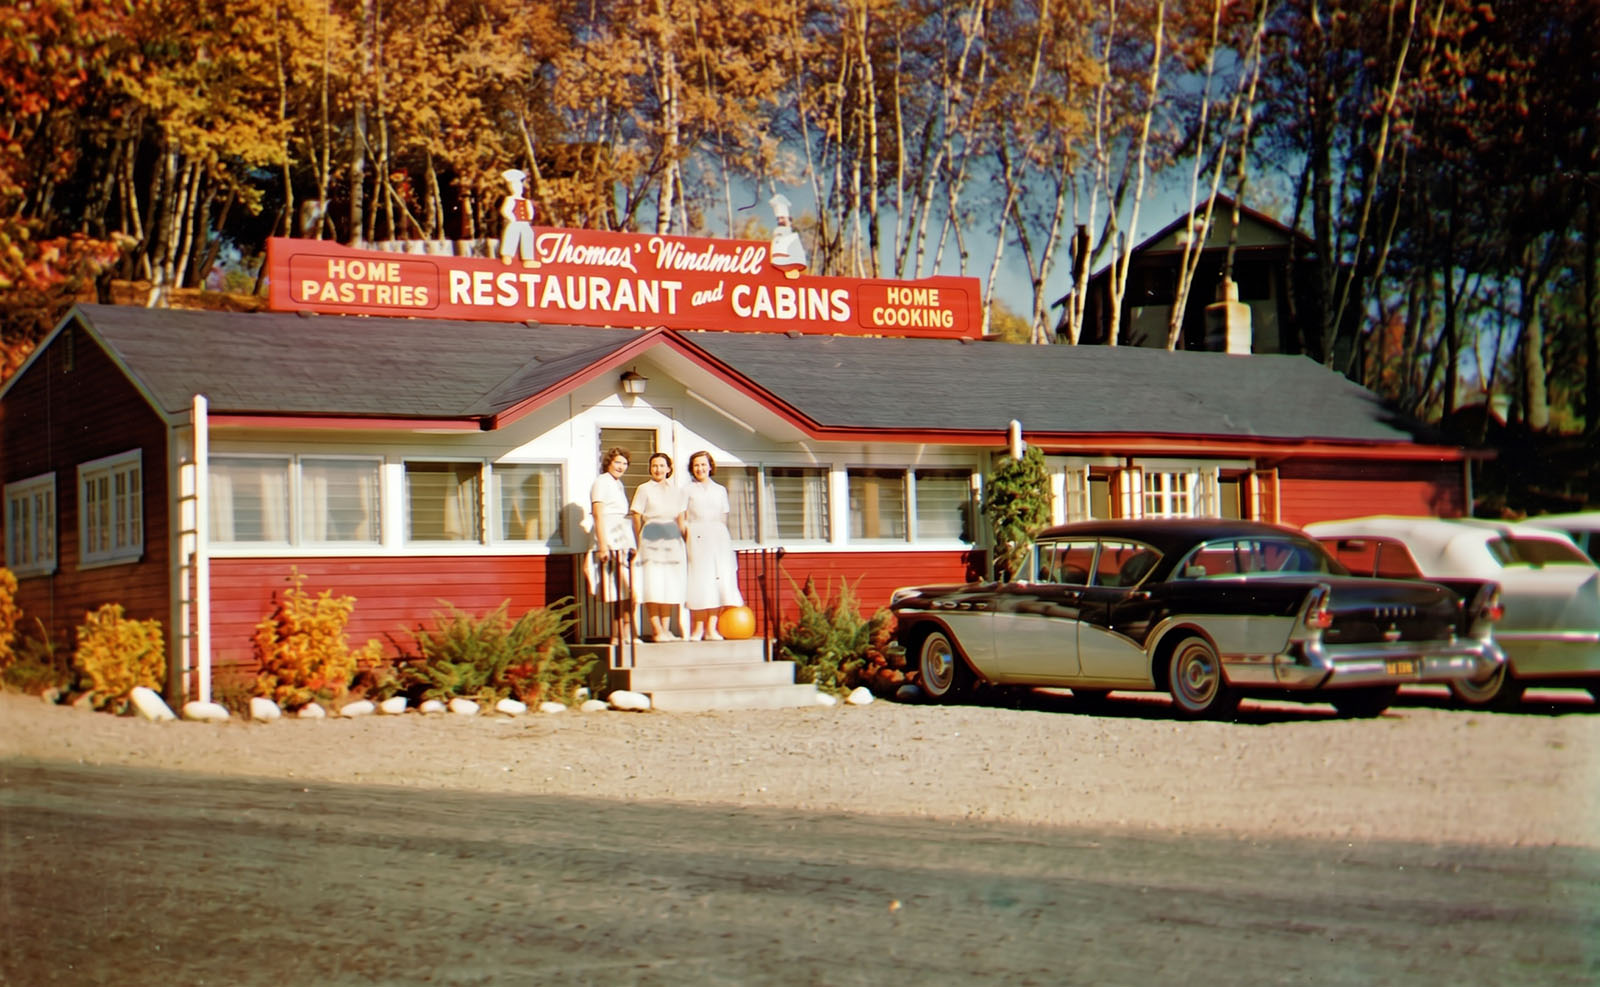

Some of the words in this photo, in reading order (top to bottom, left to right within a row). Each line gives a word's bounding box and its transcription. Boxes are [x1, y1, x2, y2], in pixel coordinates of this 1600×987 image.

[536, 232, 641, 274] Thomas'
[649, 236, 766, 275] Windmill
[328, 259, 401, 283] HOME
[302, 279, 429, 307] PASTRIES
[449, 269, 682, 315] RESTAURANT
[691, 281, 724, 307] and
[731, 284, 851, 322] CABINS
[886, 287, 940, 307] HOME
[872, 306, 954, 328] COOKING
